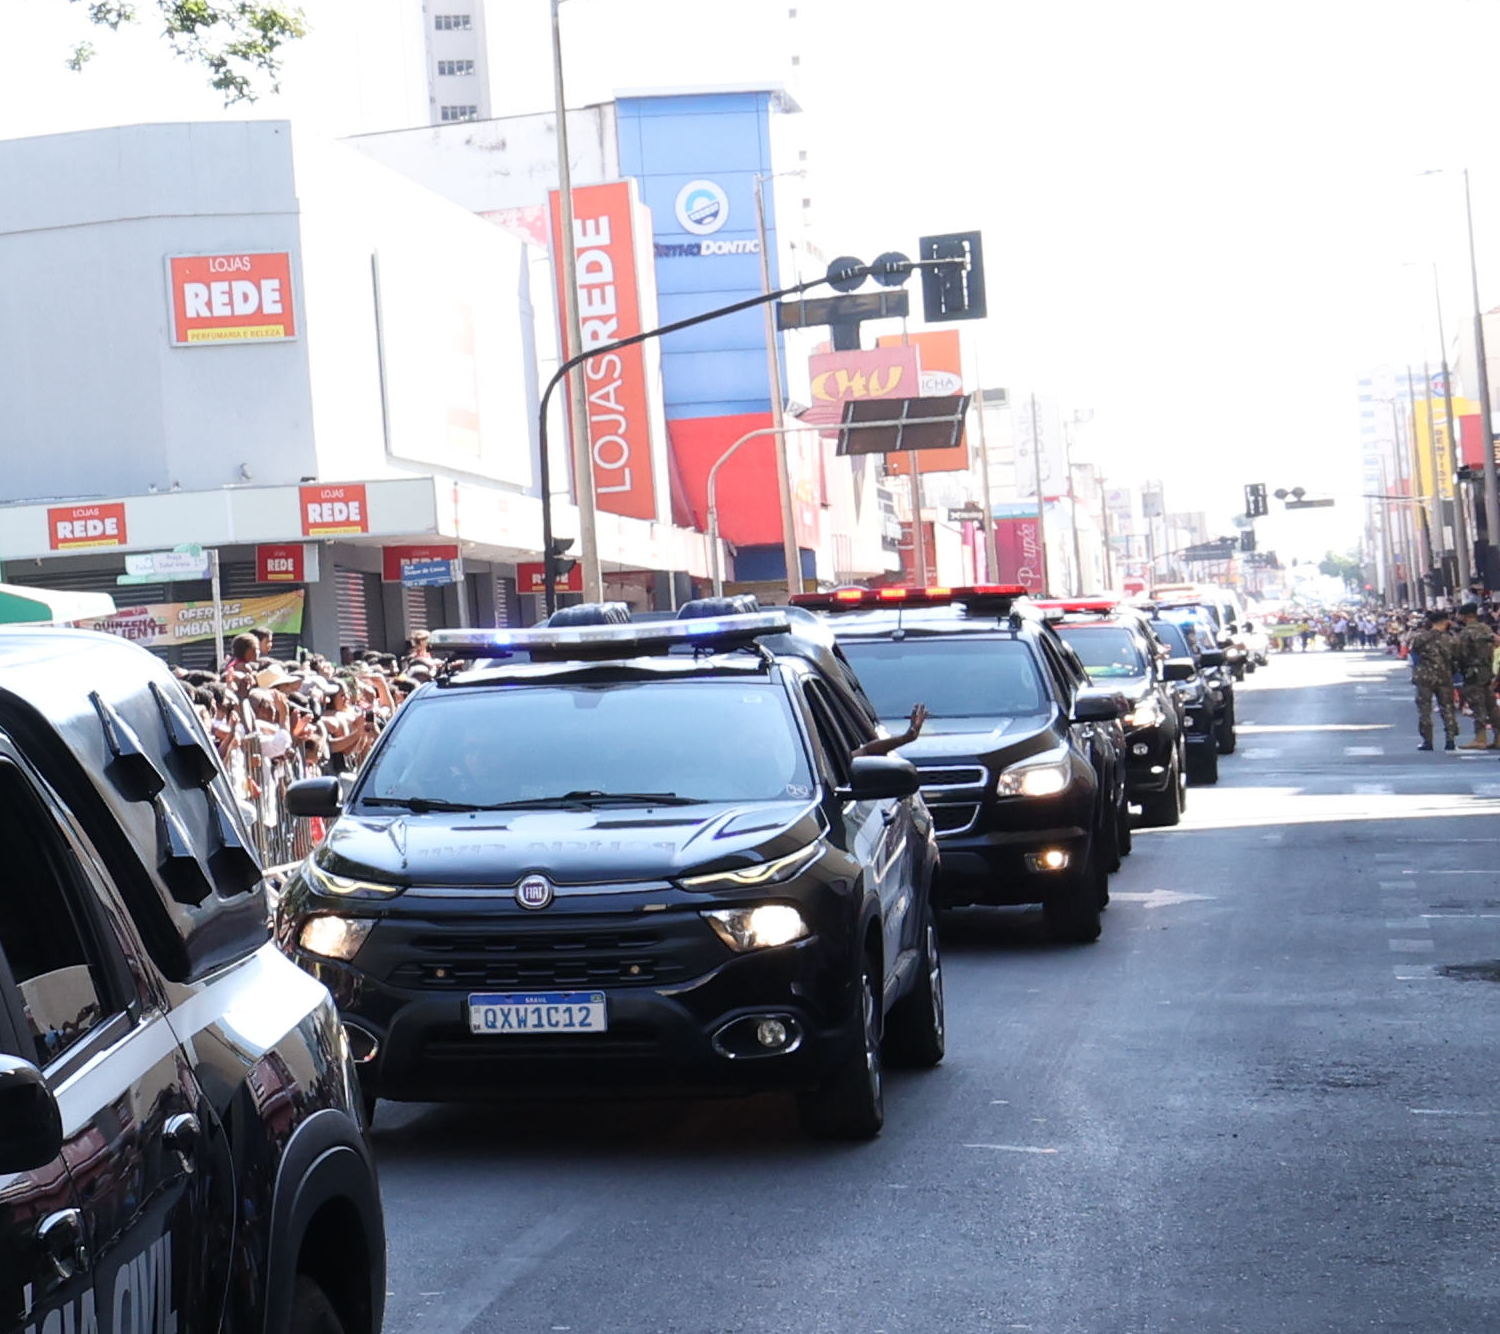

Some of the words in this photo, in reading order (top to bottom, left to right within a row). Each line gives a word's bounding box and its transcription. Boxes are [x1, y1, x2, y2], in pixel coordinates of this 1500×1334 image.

[209, 256, 251, 272] LOJAS
[573, 215, 619, 350] REDE
[183, 278, 283, 318] REDE
[191, 332, 242, 341] PERFUMARIA
[250, 329, 281, 338] BELEZA
[587, 353, 632, 494] LOJAS
[320, 489, 345, 499] LOJAS
[72, 508, 100, 518] LOJAS
[307, 501, 361, 524] REDE
[56, 517, 119, 539] REDE
[267, 558, 294, 572] REDE
[178, 603, 242, 621] OFERAS
[174, 615, 255, 638] IMBATVEIS
[525, 885, 544, 900] FIAT
[483, 1006, 593, 1029] QXW1C12
